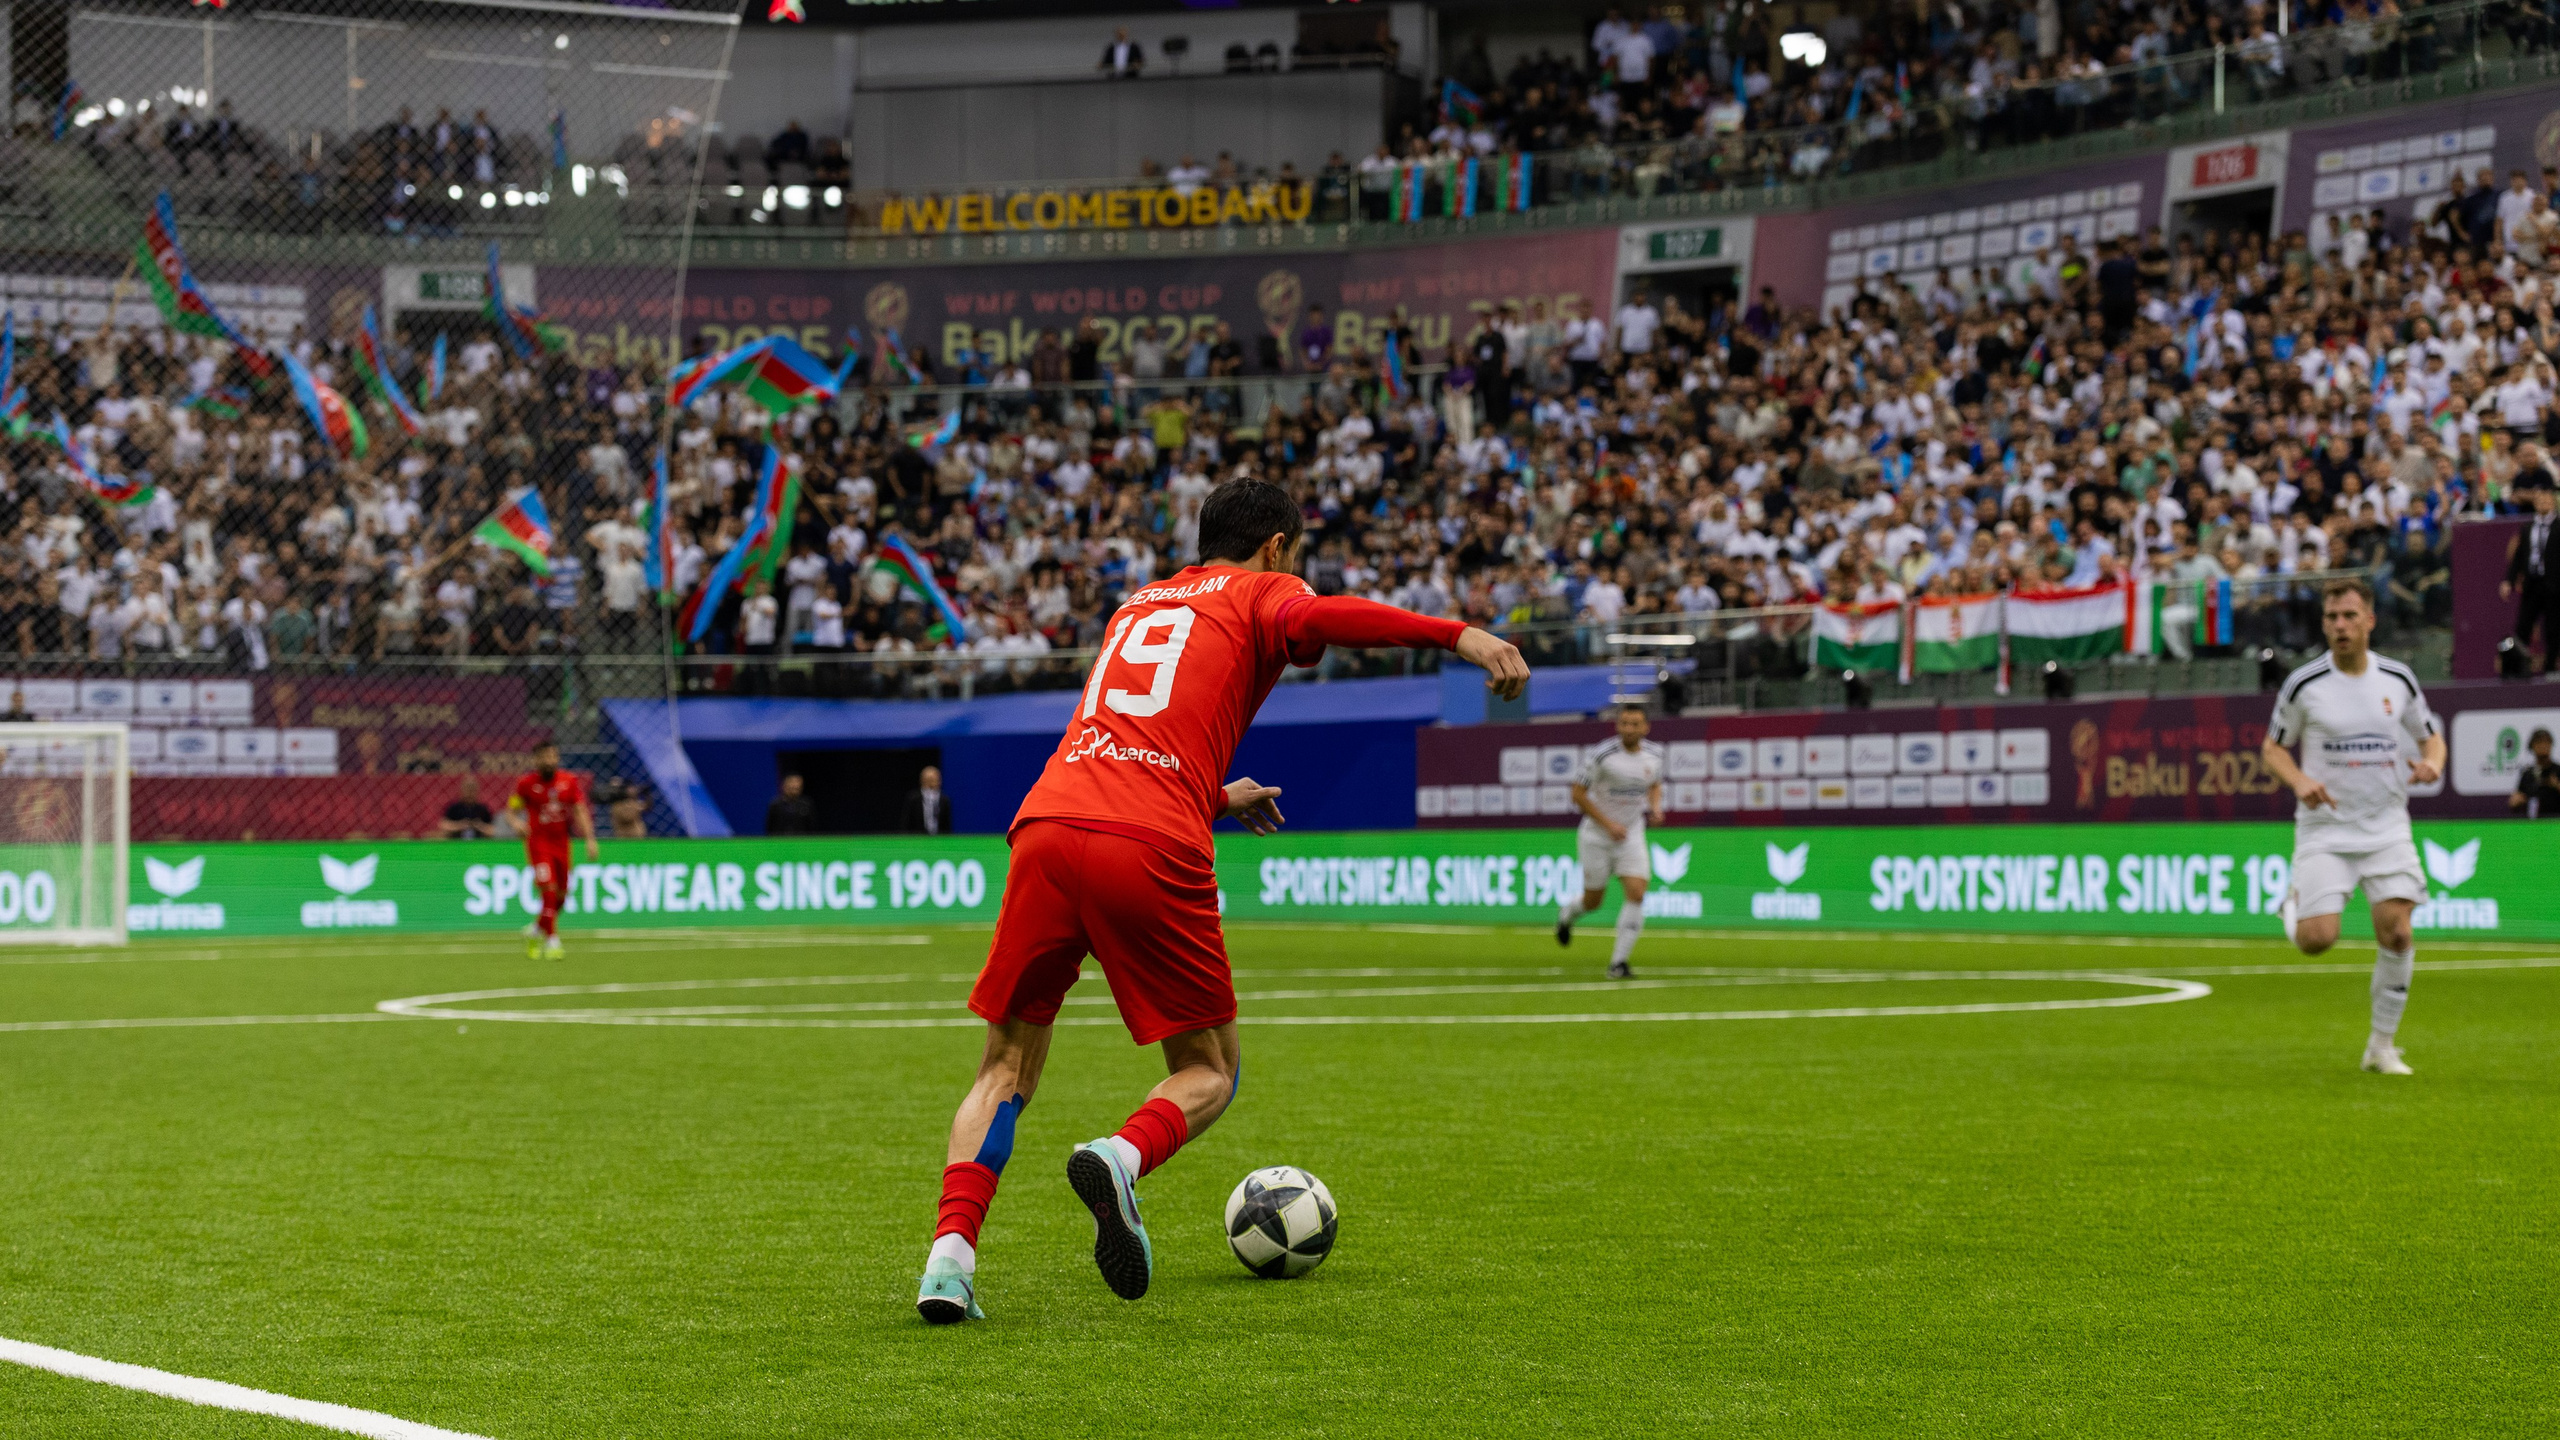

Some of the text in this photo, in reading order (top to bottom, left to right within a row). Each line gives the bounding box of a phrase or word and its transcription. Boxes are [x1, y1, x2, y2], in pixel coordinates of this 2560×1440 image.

[880, 184, 1313, 234] #WELCOMETOBAKU
[766, 294, 832, 321] CUP
[944, 283, 1222, 316] WMF WORLD CUP
[942, 315, 1075, 367] Bak
[1119, 575, 1232, 610] ZERBAIJAN
[1082, 605, 1196, 721] 19
[1100, 742, 1180, 772] Azercell
[2106, 750, 2281, 798] Baku 2025
[754, 860, 878, 911] SINCE
[884, 858, 987, 909] 1900
[1259, 856, 1431, 906] SPORTSWEAR
[1434, 855, 1518, 906] SINCE
[1869, 854, 2290, 915] SPORTSWEAR SINCE 19
[126, 897, 226, 931] erima
[300, 895, 398, 929] erima
[1751, 887, 1822, 920] erima
